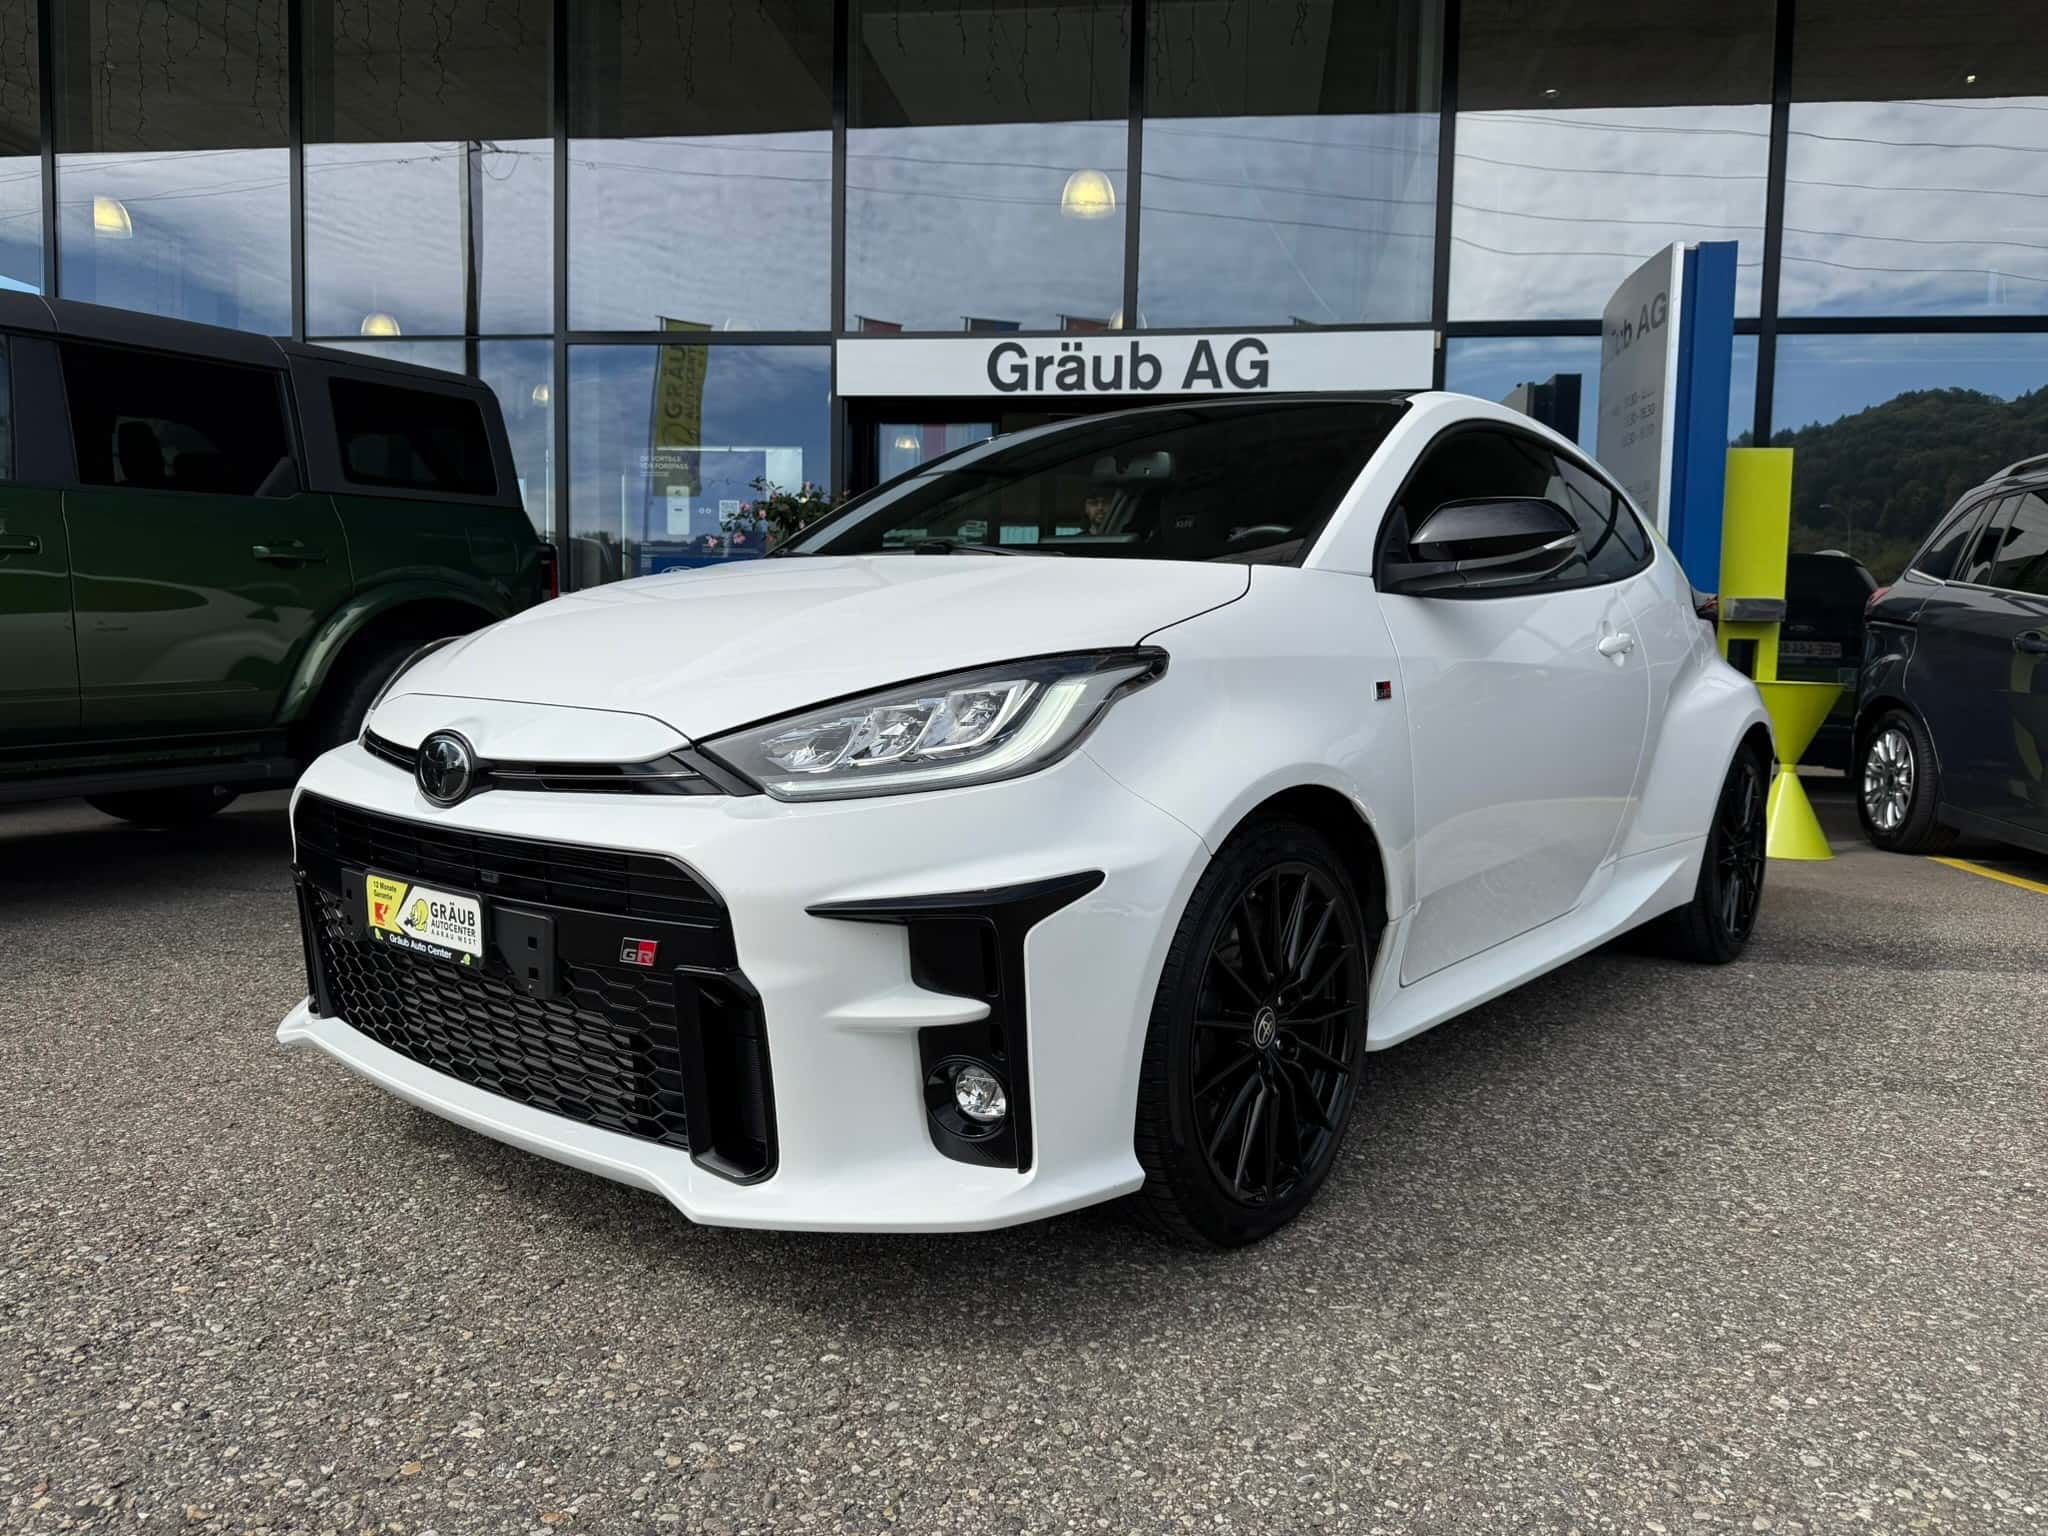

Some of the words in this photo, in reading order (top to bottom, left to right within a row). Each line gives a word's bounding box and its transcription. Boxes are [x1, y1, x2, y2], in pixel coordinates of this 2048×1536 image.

[1636, 291, 1667, 341] AG
[987, 341, 1162, 393] Gräub
[1181, 337, 1269, 390] AG
[663, 345, 686, 418] GRÄU
[430, 901, 476, 927] GRÄUB
[431, 919, 476, 938] AUTOCENTER
[389, 933, 410, 948] Gräub
[410, 940, 427, 953] Auto
[427, 944, 452, 959] Center
[622, 948, 654, 963] GR
